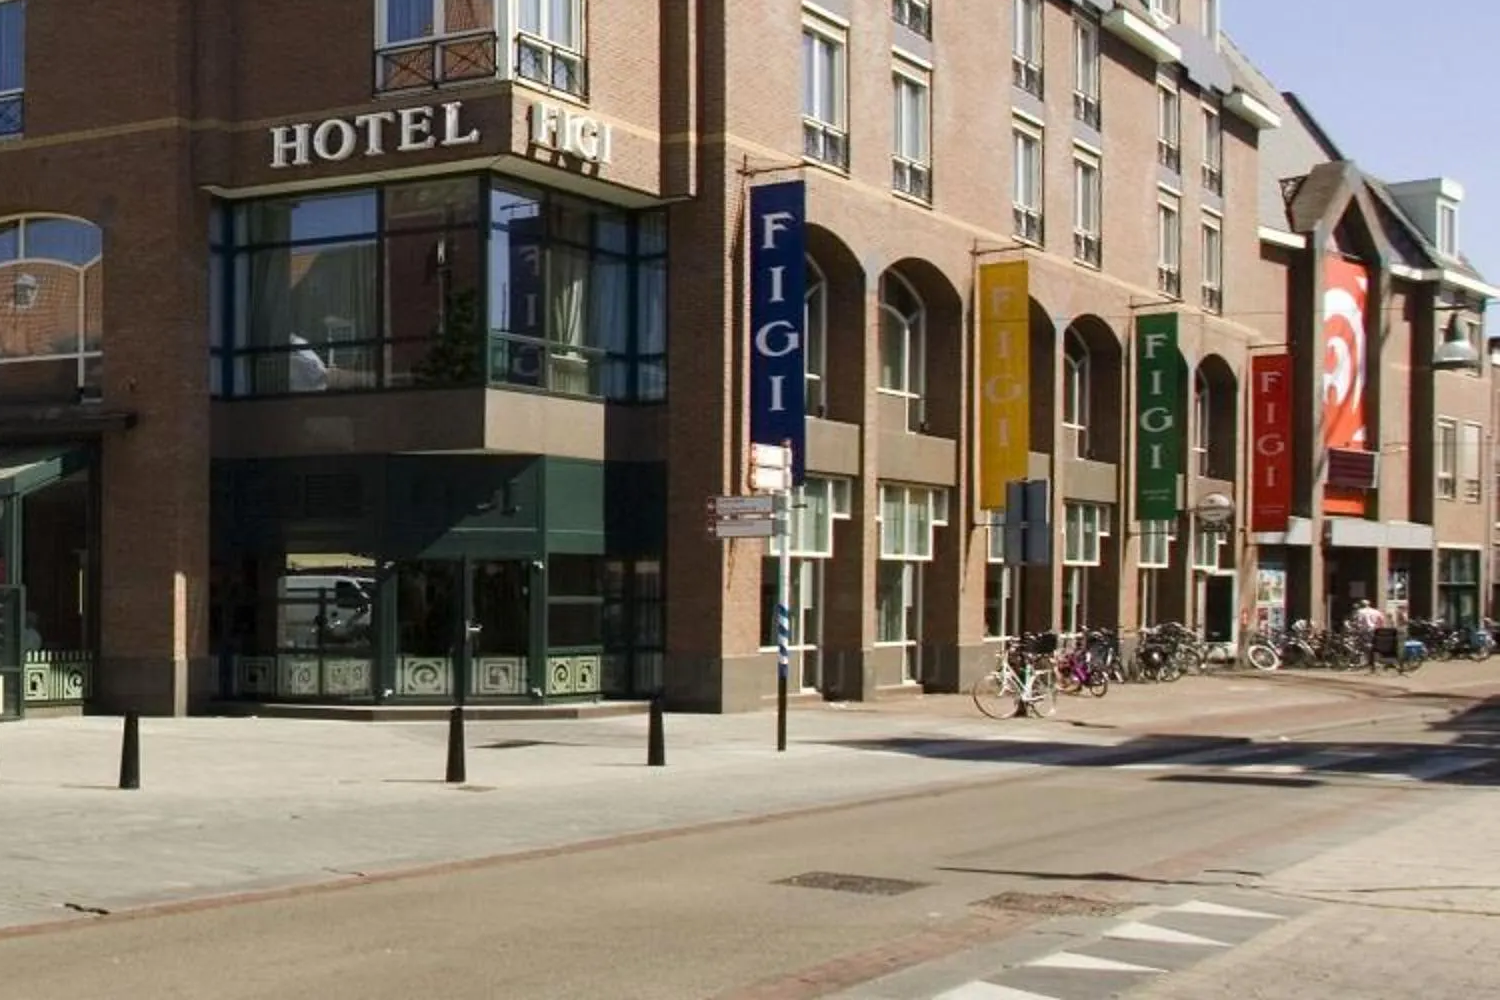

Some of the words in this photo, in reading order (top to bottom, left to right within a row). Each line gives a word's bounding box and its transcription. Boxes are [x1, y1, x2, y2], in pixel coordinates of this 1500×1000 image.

[269, 101, 481, 169] HOTEL
[530, 100, 612, 165] FIGI
[755, 211, 799, 412] FIGI
[985, 285, 1023, 447] FIGI
[1139, 332, 1174, 470] FIGI
[1256, 370, 1285, 488] FIGI
